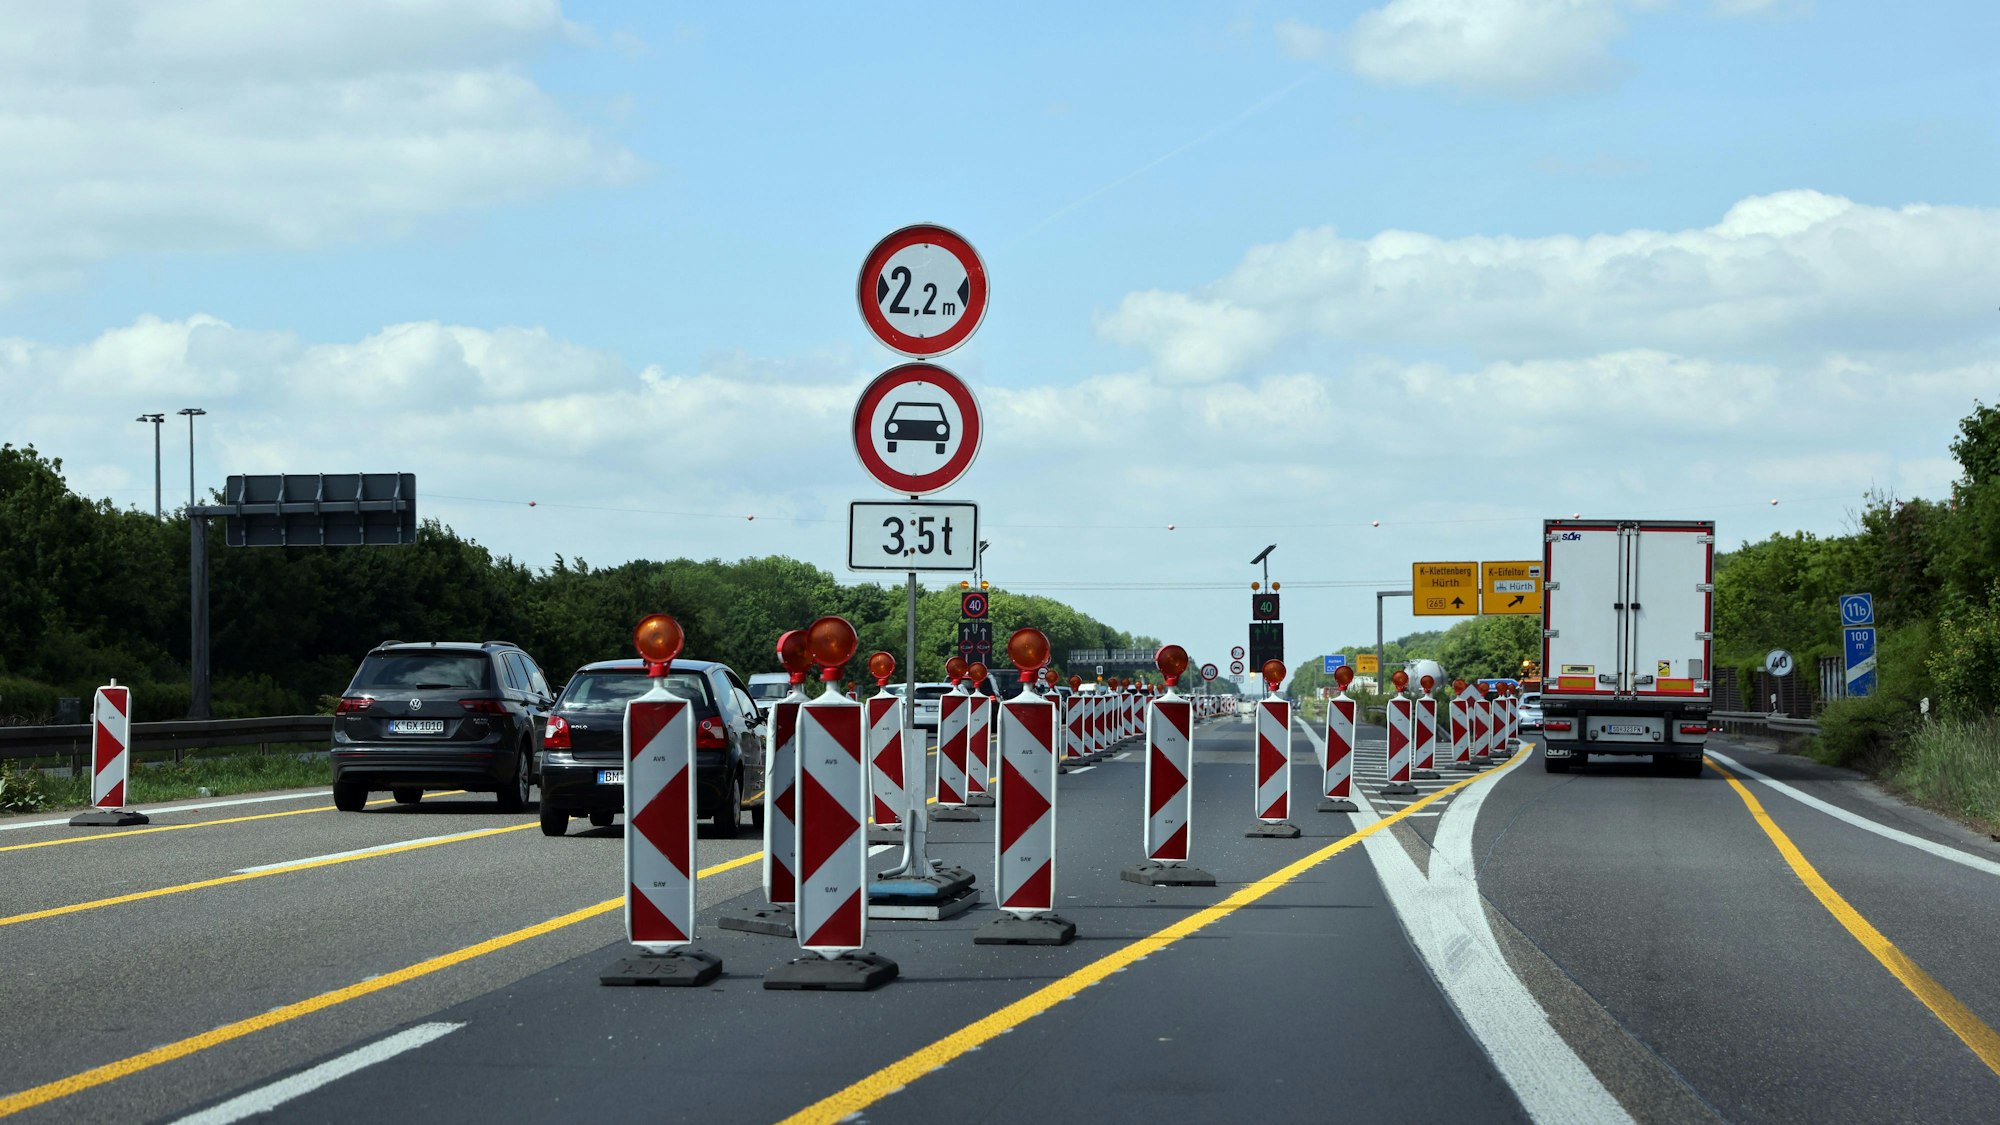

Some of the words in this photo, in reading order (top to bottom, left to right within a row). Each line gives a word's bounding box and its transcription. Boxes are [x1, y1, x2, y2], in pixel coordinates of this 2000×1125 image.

[1420, 567, 1472, 577] K-Klettenberg
[1488, 567, 1525, 577] K-Eifeltor
[1432, 578, 1460, 588] Hürth
[1509, 582, 1533, 591] Hürth
[968, 600, 981, 611] 40
[1260, 601, 1273, 613] 40
[1429, 599, 1444, 608] 265
[1847, 602, 1867, 617] 11b
[1851, 631, 1869, 641] 100
[1771, 656, 1787, 669] 40
[1204, 668, 1215, 677] 40
[394, 721, 400, 730] K
[406, 721, 418, 730] GX
[420, 721, 442, 730] 1010
[605, 771, 619, 782] BM
